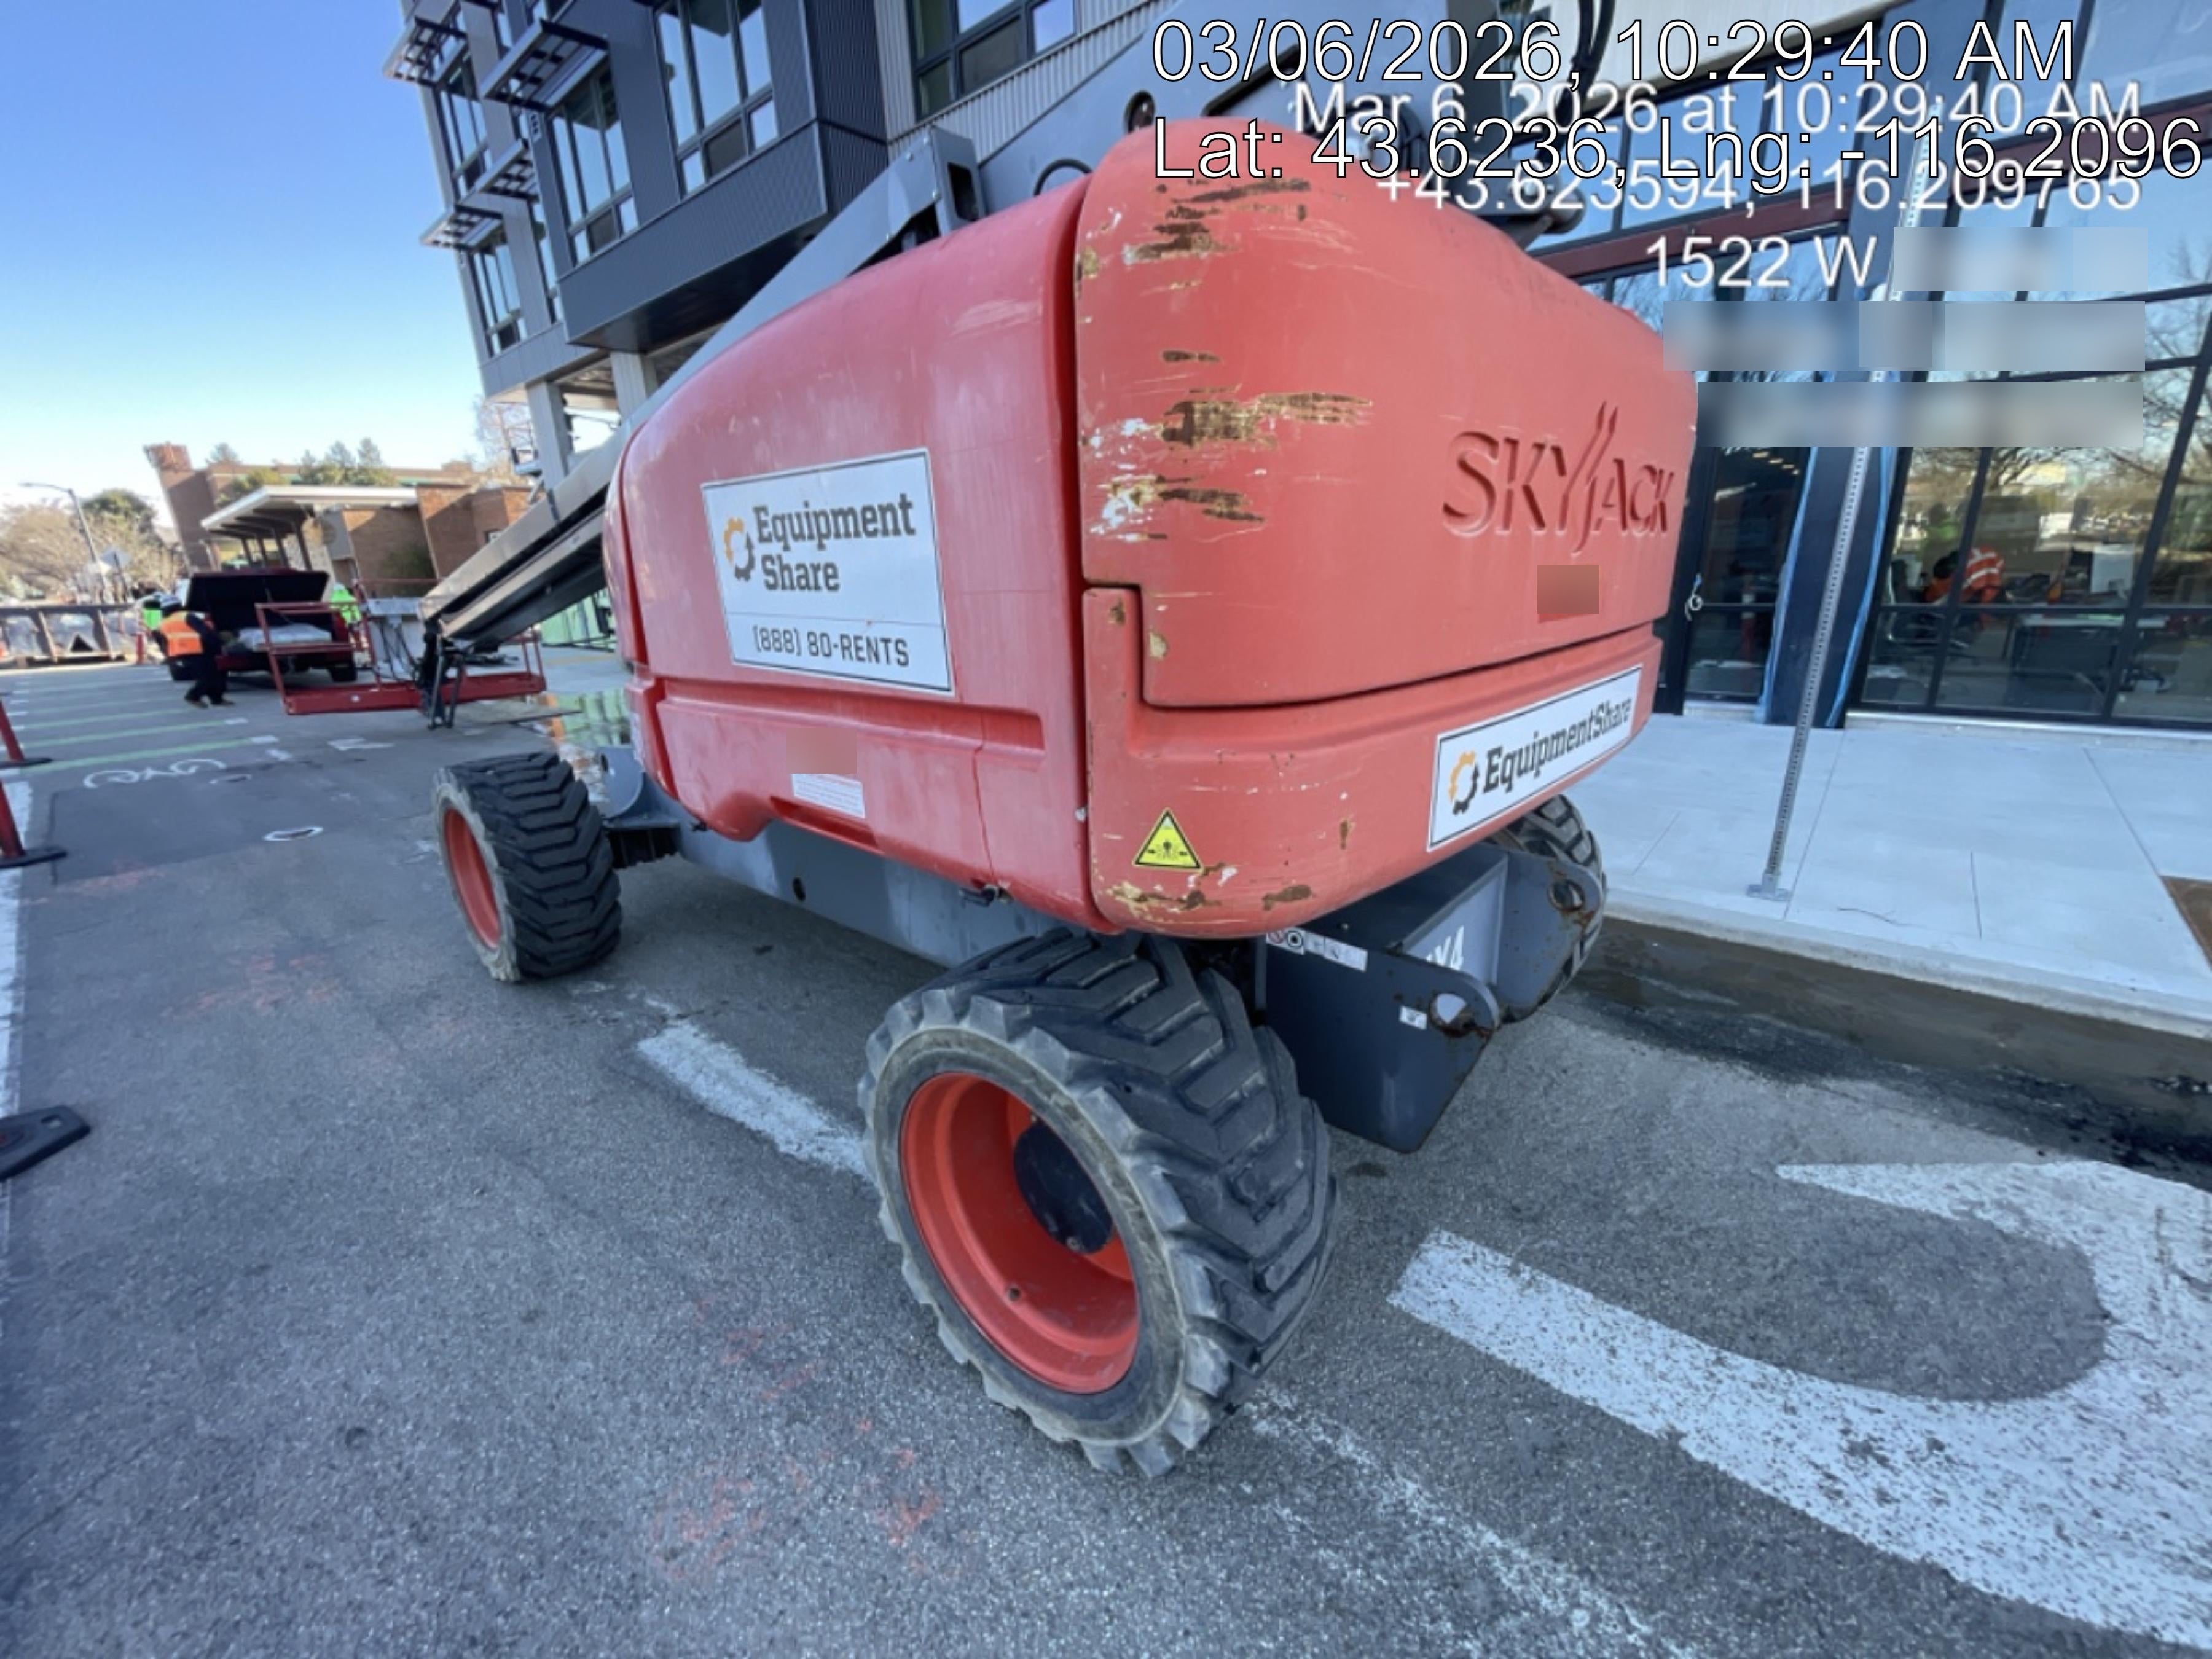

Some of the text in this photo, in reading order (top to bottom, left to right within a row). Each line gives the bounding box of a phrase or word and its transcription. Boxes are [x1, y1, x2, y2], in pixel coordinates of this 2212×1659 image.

[1443, 401, 1675, 558] SKYJACK
[753, 493, 917, 552] Equipment
[761, 553, 841, 592] Share
[753, 625, 910, 667] (888) 80-RENTS
[1482, 698, 1633, 794] EquipmentShare
